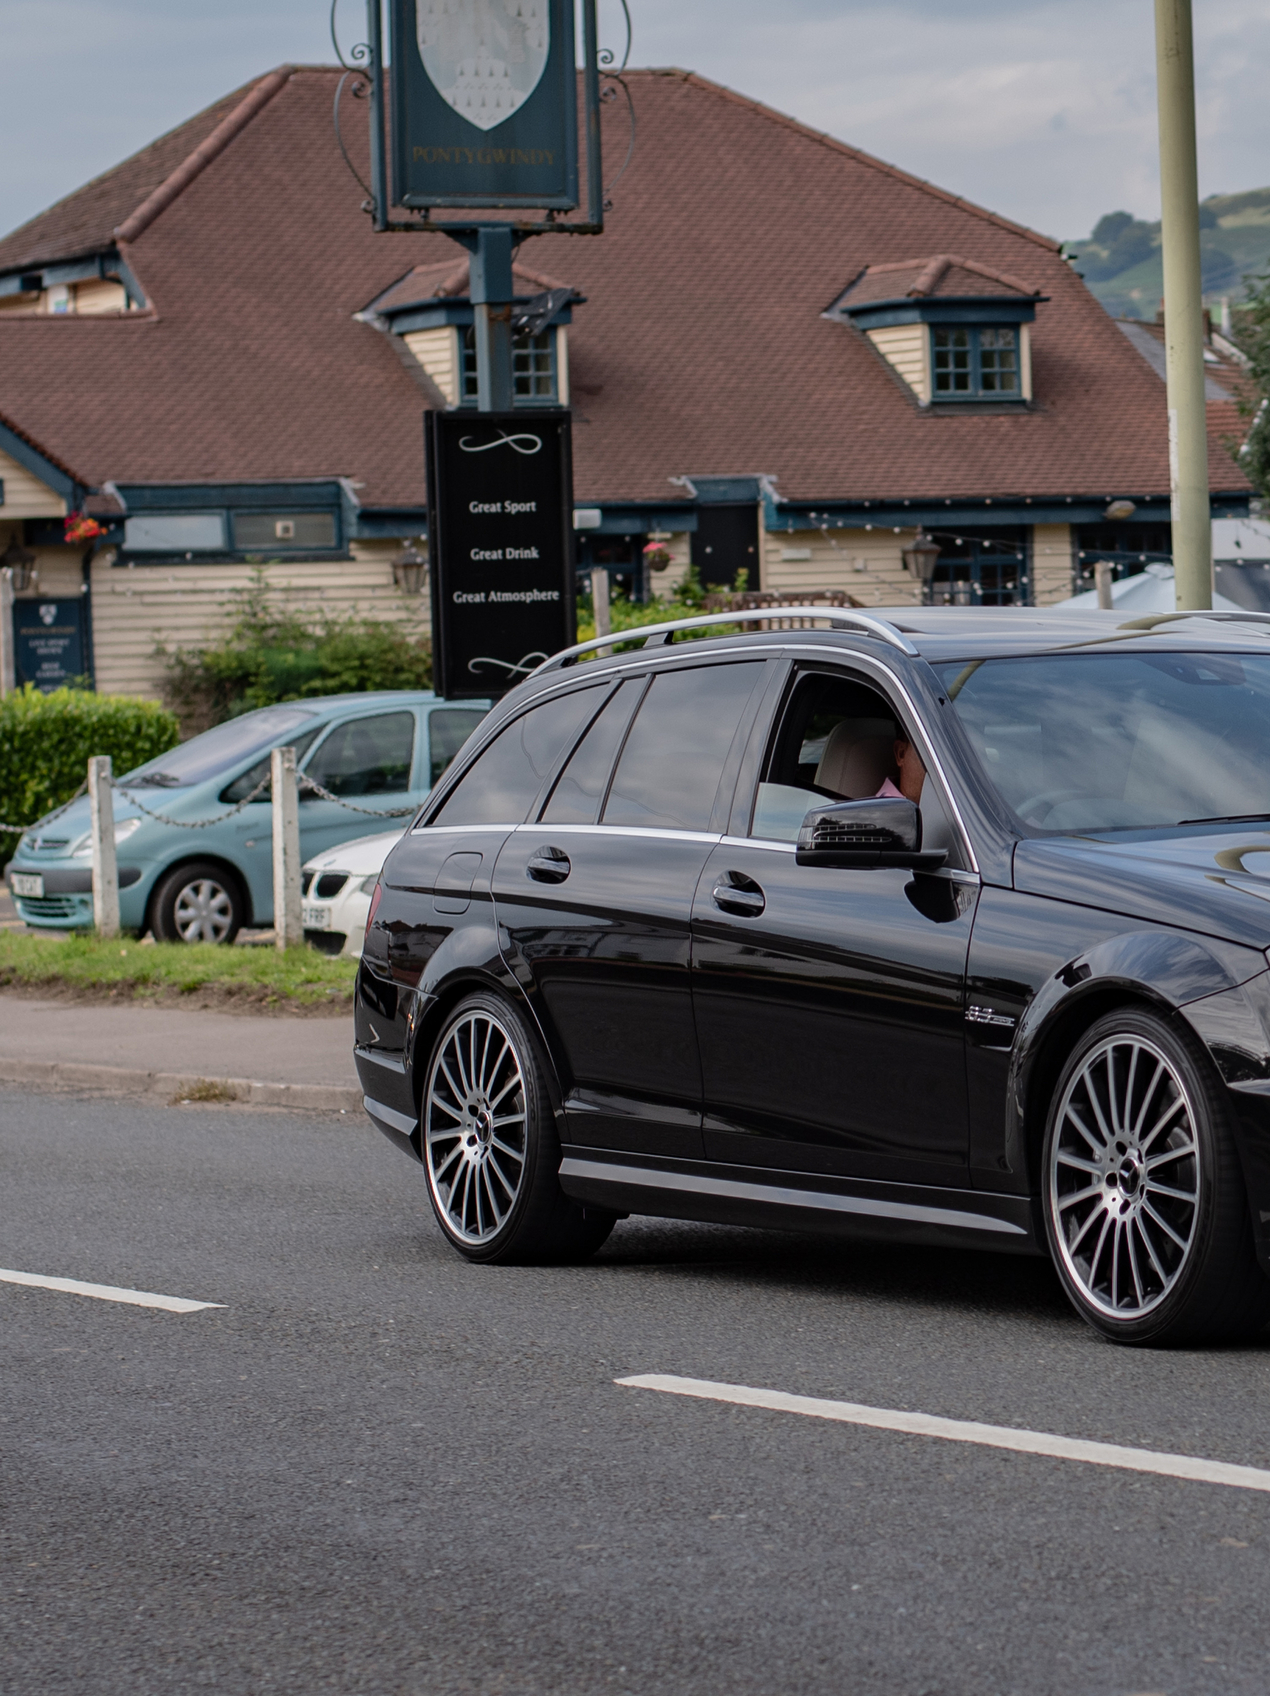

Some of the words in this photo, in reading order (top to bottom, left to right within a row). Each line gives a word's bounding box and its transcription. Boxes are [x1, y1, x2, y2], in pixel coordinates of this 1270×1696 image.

[413, 146, 554, 165] PONTYGWINDY
[469, 501, 502, 513] Great
[504, 500, 537, 514] Sport
[470, 548, 503, 560] Great
[505, 546, 539, 560] Drink
[453, 591, 486, 603] Great
[487, 588, 560, 603] Atmosphere
